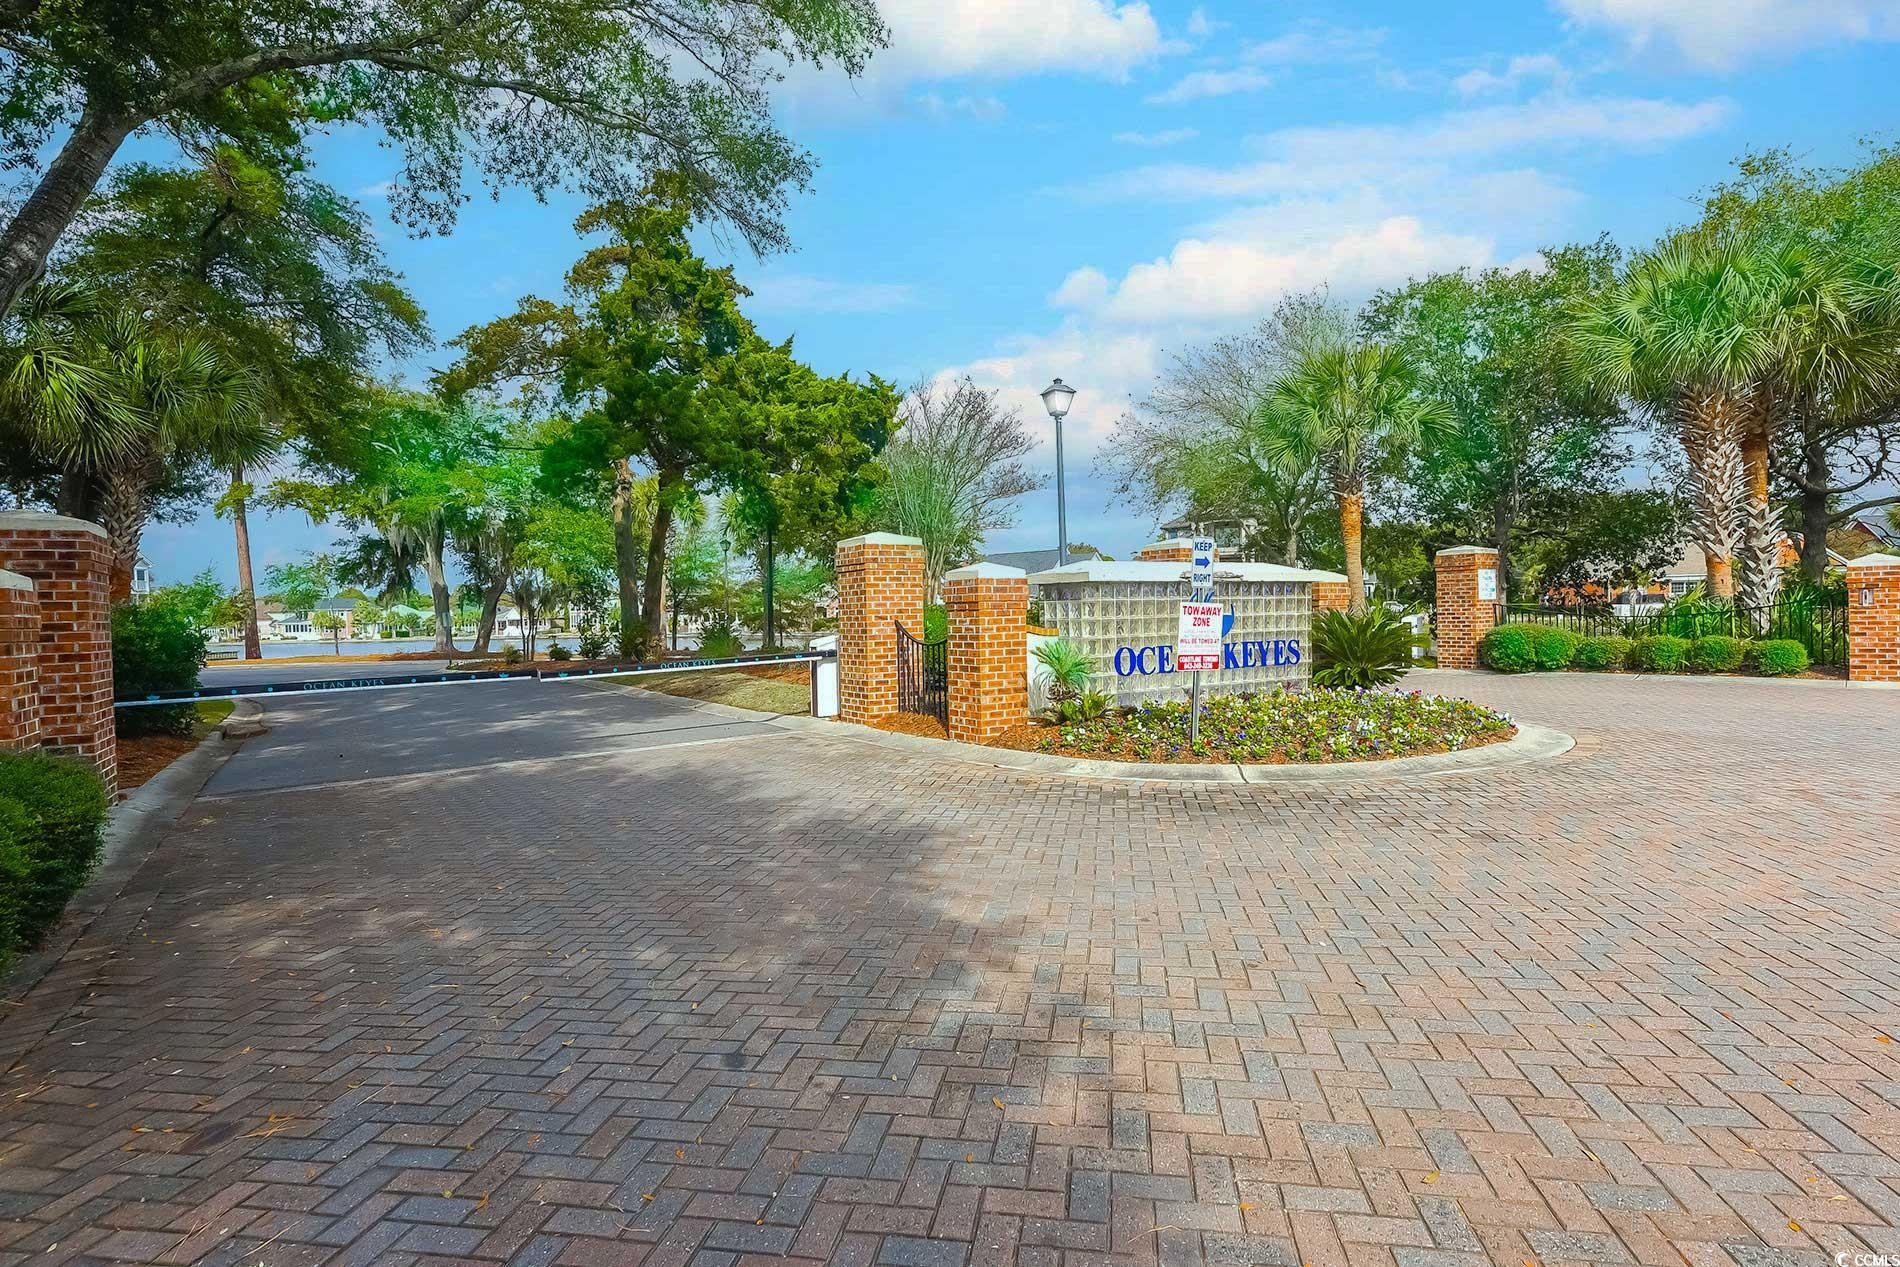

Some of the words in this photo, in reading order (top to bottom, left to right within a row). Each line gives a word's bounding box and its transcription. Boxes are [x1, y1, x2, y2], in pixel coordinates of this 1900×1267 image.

[1194, 541, 1213, 551] KEEP
[1193, 573, 1211, 583] RIGHT
[1182, 605, 1200, 616] TOW
[1200, 606, 1222, 616] AWAY
[1192, 617, 1211, 627] ZONE
[1114, 645, 1178, 677] OCE
[1223, 639, 1301, 670] KEYES
[661, 661, 690, 669] OCEAN
[303, 681, 346, 691] OCEAN
[351, 679, 385, 688] KEYES
